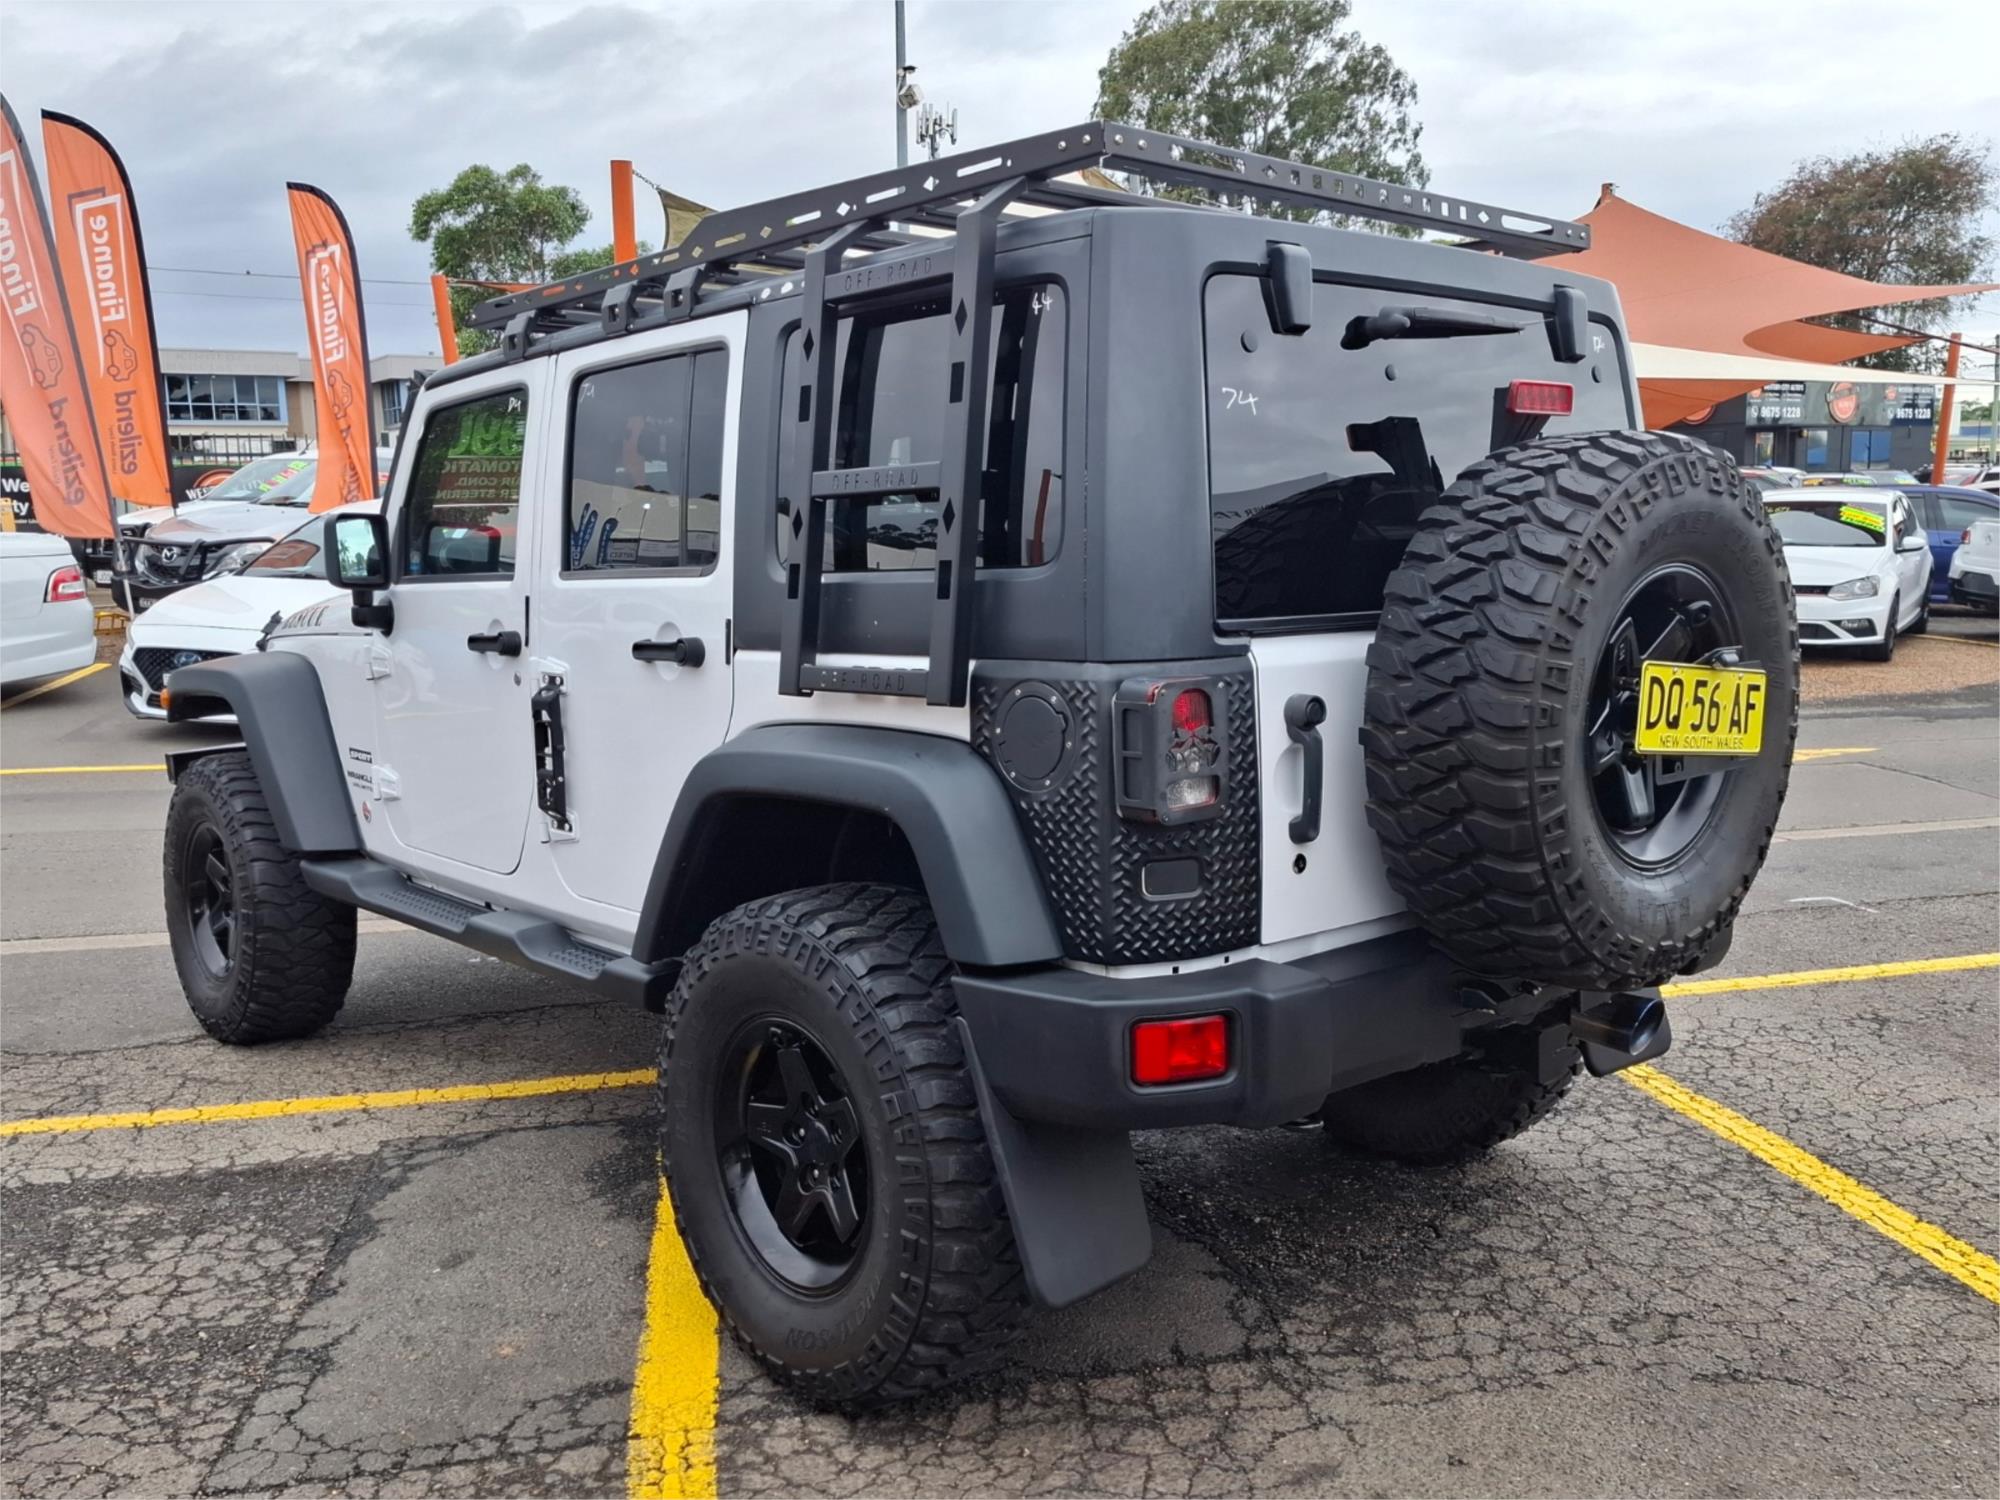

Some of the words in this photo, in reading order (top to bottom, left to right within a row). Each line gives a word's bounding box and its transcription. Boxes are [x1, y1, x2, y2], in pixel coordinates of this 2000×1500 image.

[1221, 387, 1259, 416] 74
[1, 477, 30, 493] We
[1660, 735, 1680, 748] NEW
[1684, 736, 1712, 749] SOUTH
[1717, 736, 1744, 750] WALES
[350, 749, 372, 763] SPORT
